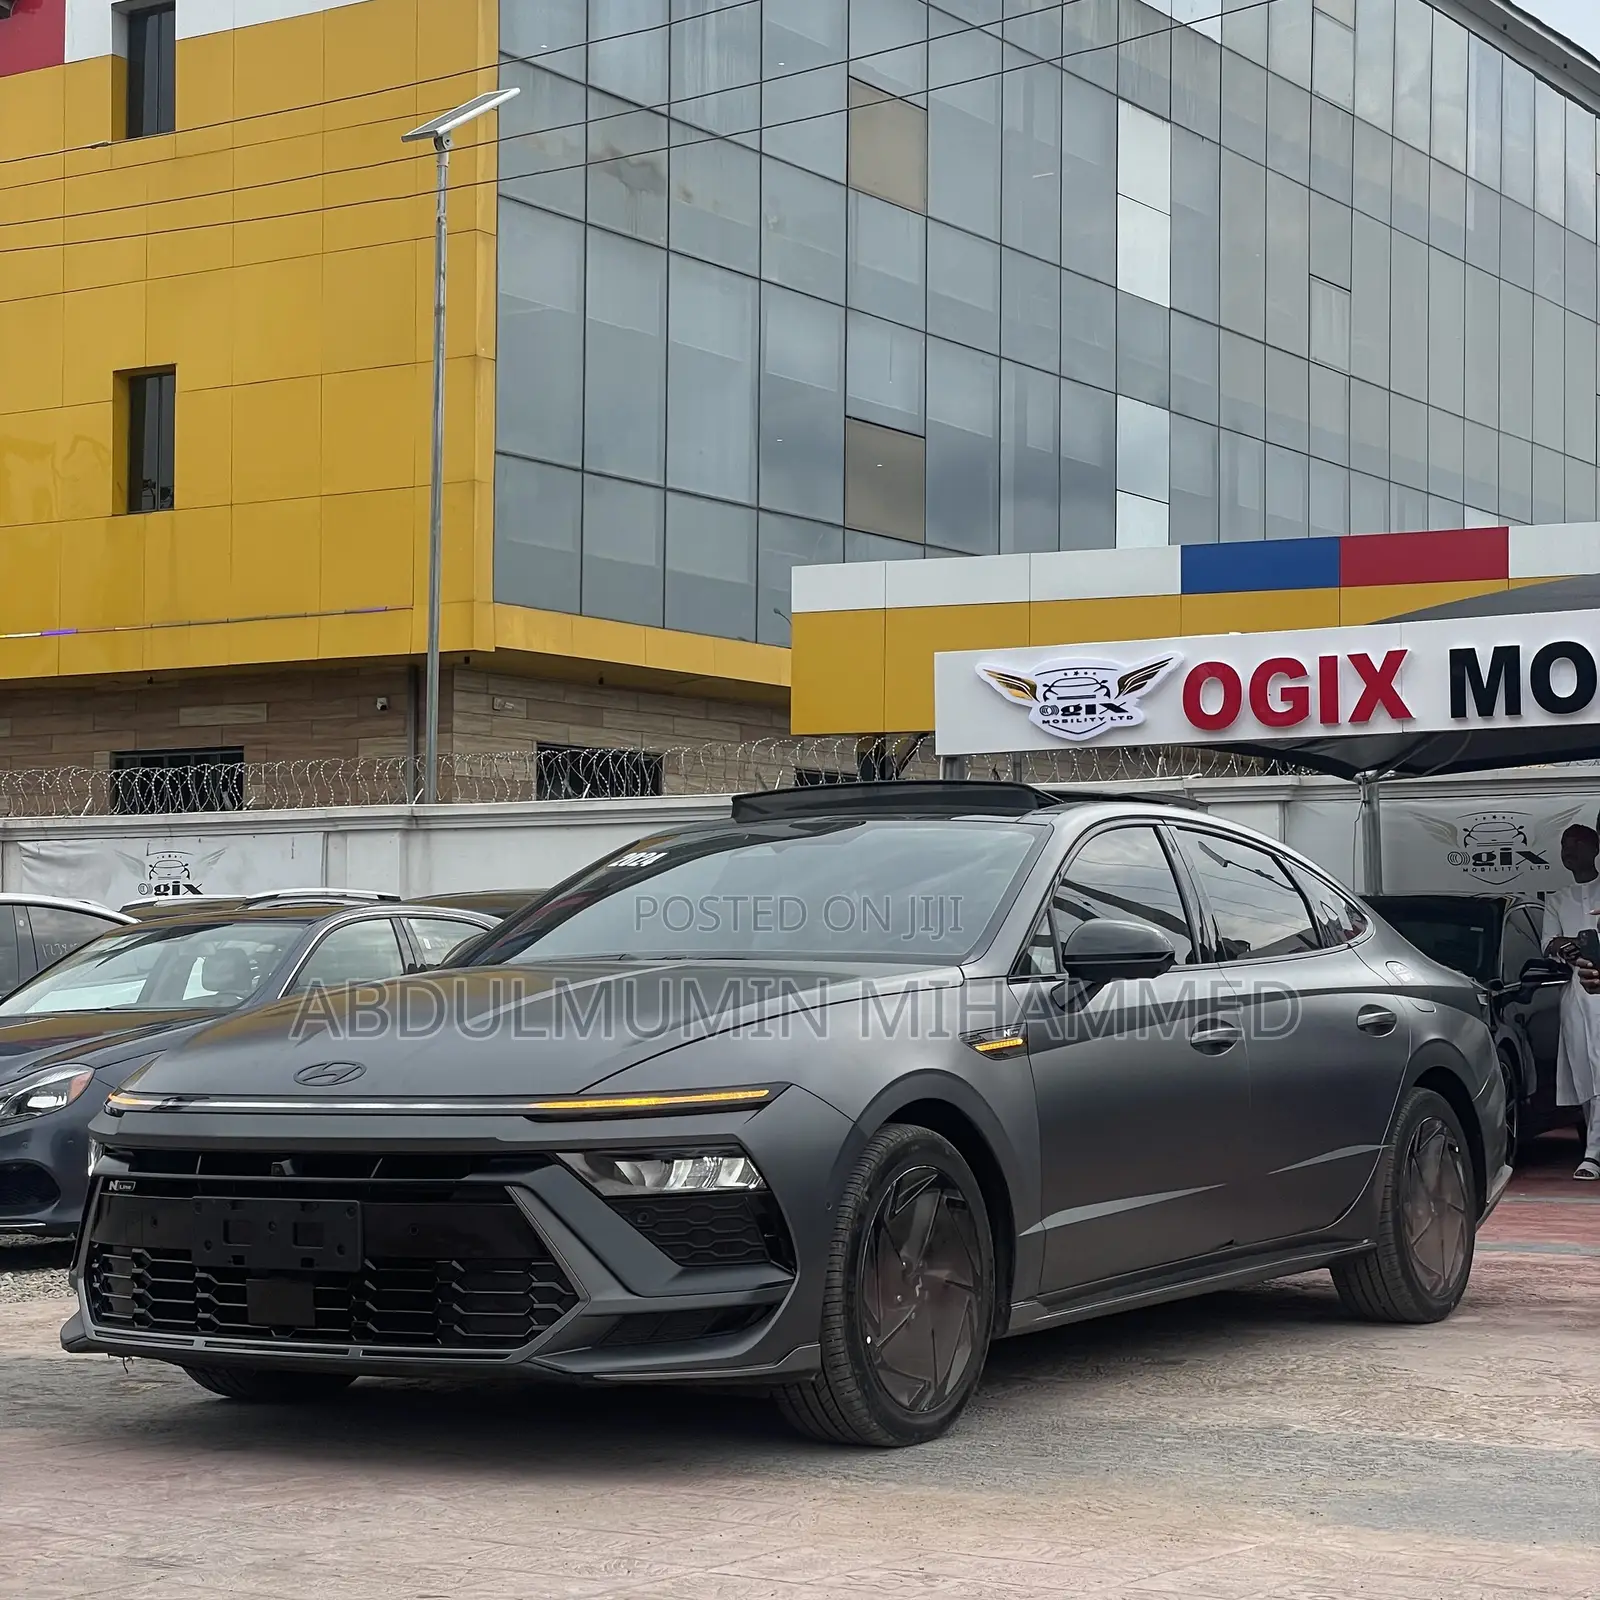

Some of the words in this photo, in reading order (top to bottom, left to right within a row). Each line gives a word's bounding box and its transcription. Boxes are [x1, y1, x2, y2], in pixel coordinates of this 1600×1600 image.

[1182, 649, 1415, 731] OGIX
[1449, 640, 1598, 719] MO
[1042, 716, 1104, 724] MOBILITY
